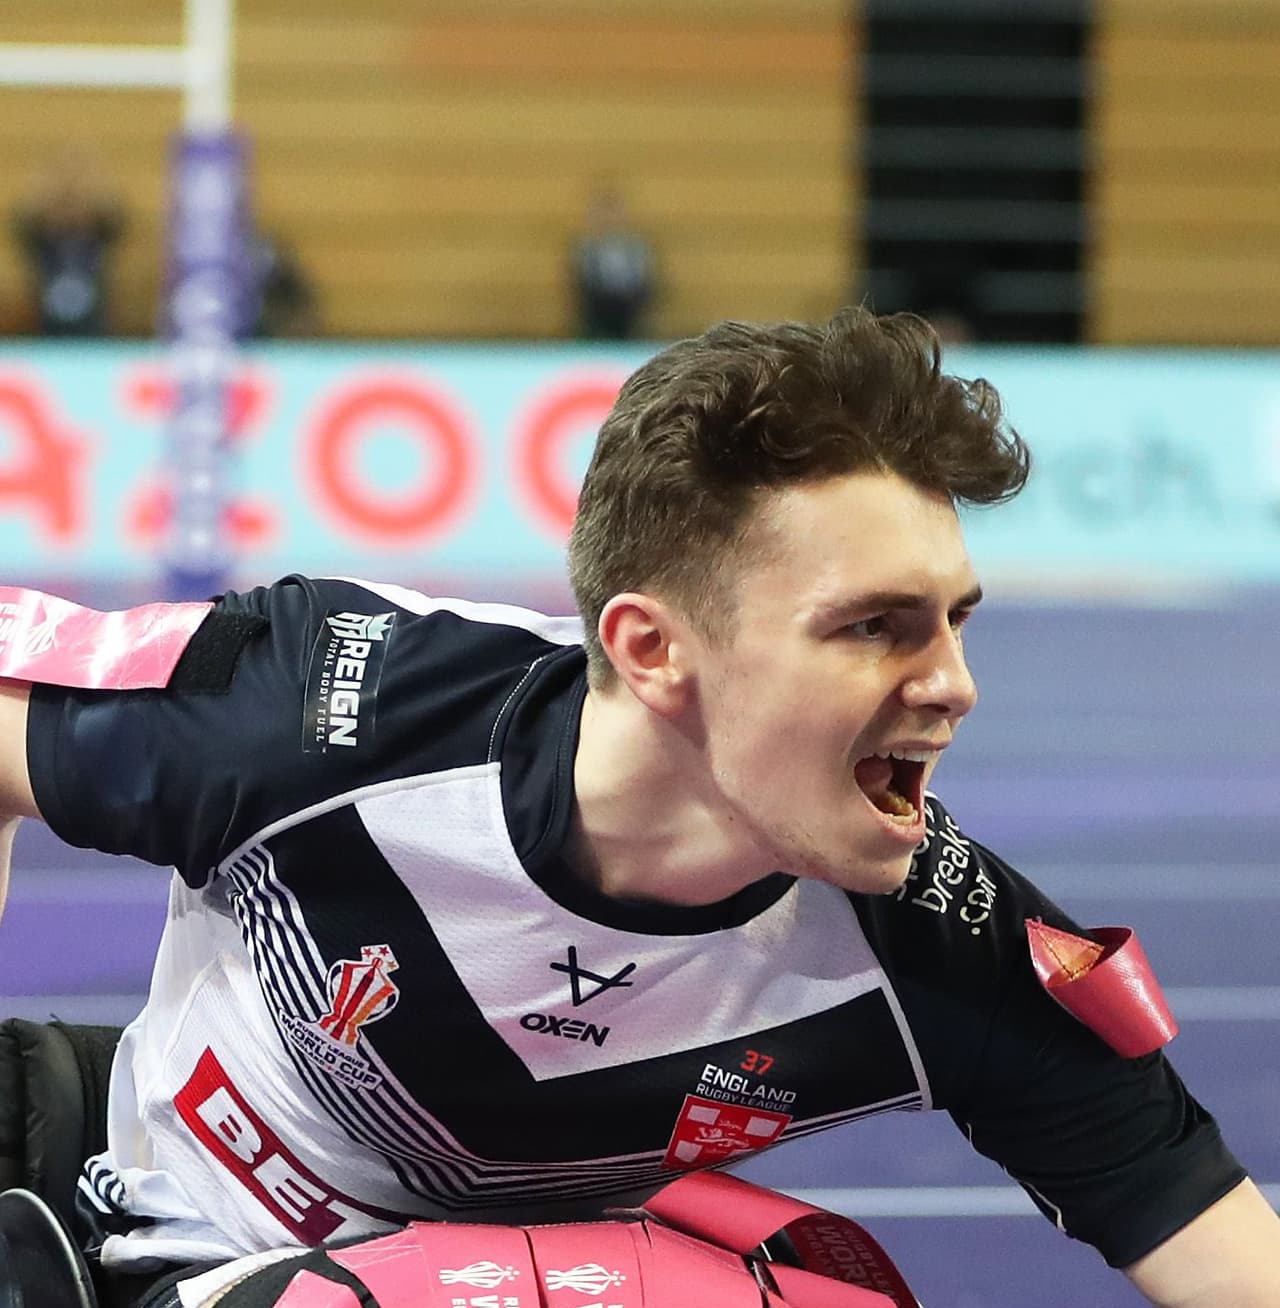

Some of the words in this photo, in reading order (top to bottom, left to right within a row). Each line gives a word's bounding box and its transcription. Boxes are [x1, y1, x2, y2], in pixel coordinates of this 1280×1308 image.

[324, 638, 340, 666] TOTAL
[319, 671, 331, 702] BODY
[328, 640, 372, 746] REIGN
[519, 1013, 610, 1047] OXEN
[281, 1014, 337, 1064] WORLD
[339, 1063, 377, 1087] CUP
[327, 1045, 365, 1068] LEAGUE
[739, 1050, 775, 1075] 37
[695, 1083, 739, 1103] RUGBY
[740, 1097, 792, 1113] LEAGUE
[700, 1063, 797, 1104] ENGLAND
[816, 1226, 875, 1287] WOR
